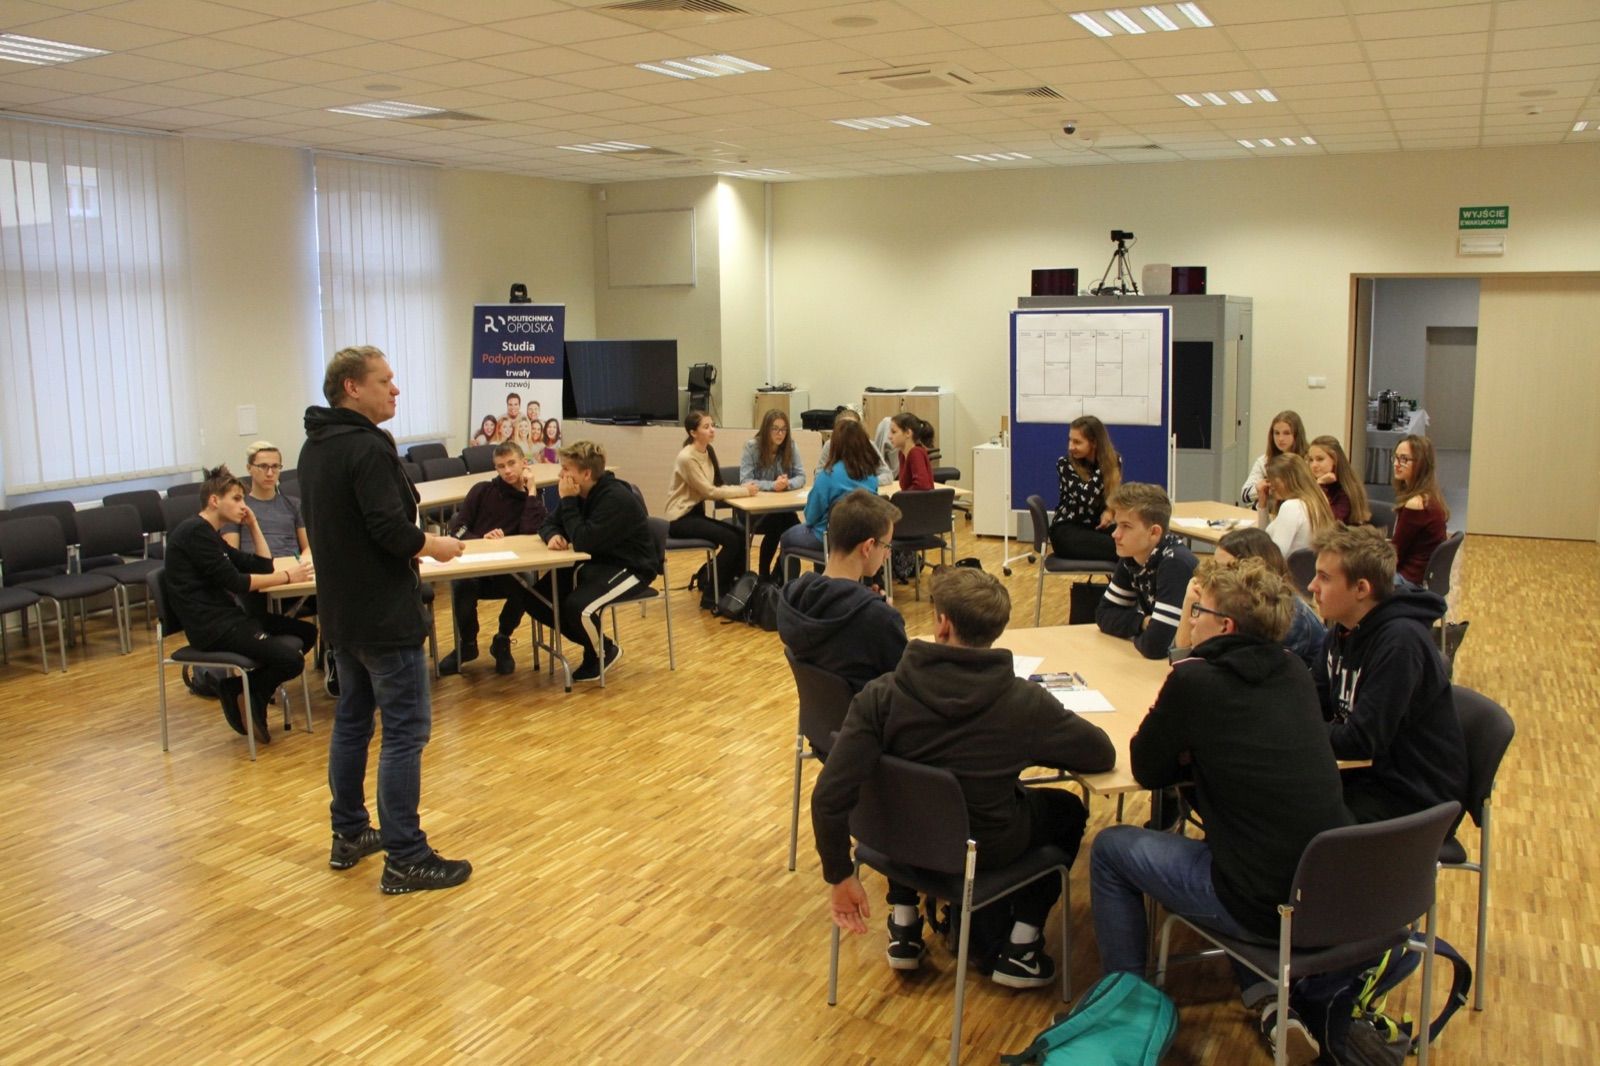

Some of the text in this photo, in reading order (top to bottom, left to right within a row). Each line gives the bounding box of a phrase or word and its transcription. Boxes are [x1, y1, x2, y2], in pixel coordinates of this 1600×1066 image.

[1462, 209, 1505, 218] WYJŚCIE
[507, 322, 554, 333] OPOLSKA
[501, 341, 536, 352] Studia
[482, 353, 556, 365] Podyplomowe
[505, 369, 531, 378] trwały
[505, 380, 531, 389] rozwój
